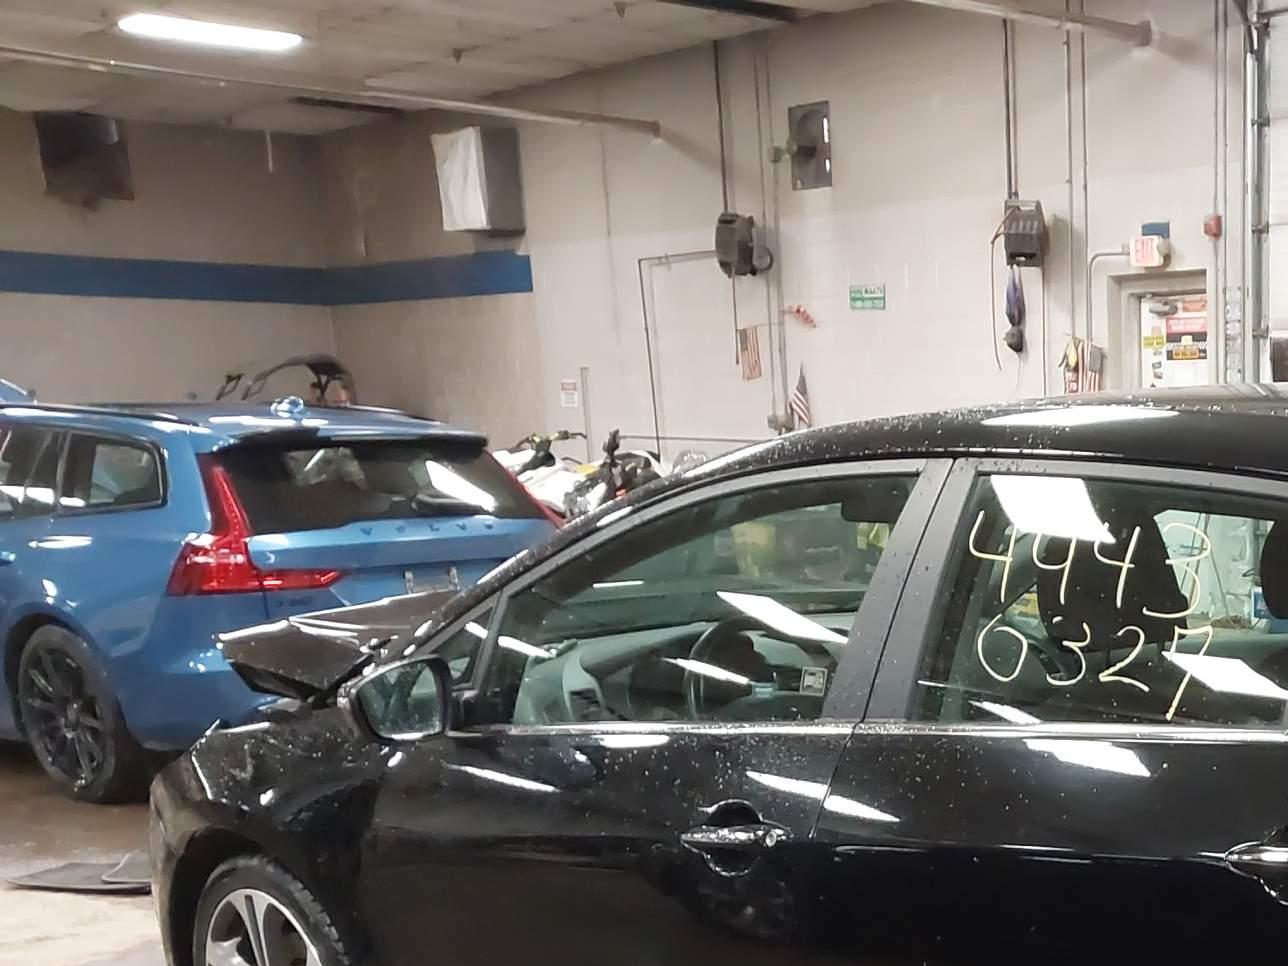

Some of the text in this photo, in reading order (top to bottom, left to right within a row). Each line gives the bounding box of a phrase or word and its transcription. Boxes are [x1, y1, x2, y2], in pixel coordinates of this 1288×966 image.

[360, 521, 494, 536] VOLVO
[969, 510, 1211, 618] 4443
[977, 613, 1213, 721] 0327
